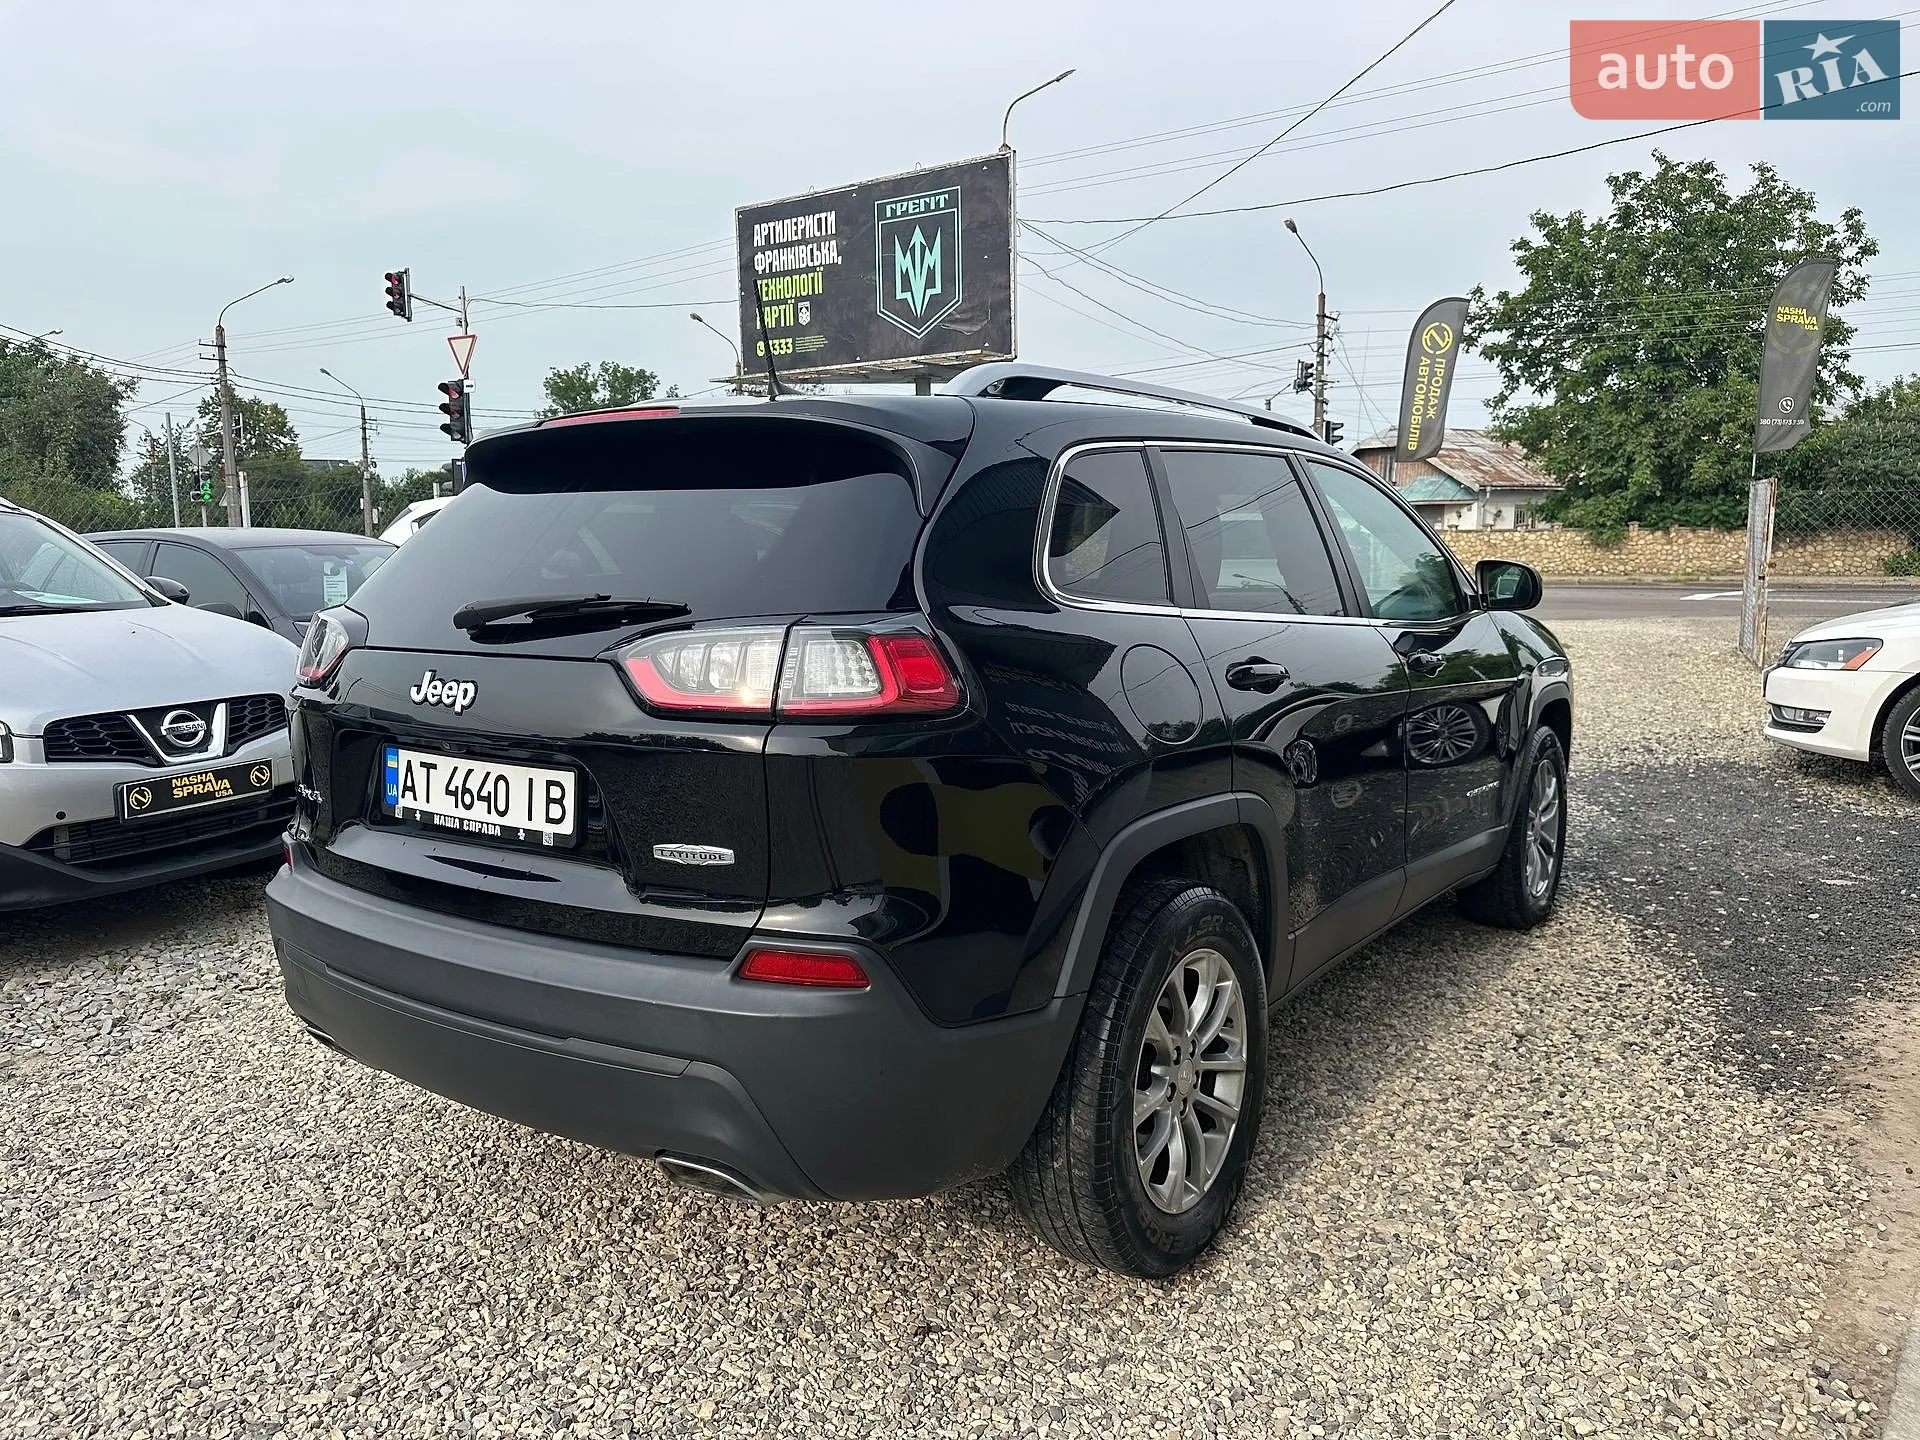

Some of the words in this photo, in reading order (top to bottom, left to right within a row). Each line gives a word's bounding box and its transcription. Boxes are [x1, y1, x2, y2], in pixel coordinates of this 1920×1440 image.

[886, 194, 948, 218] ГРЕГІТ
[753, 210, 836, 248] АРТИЛЕРИСТИ
[754, 240, 842, 275] ФРАНКІВСЬКА,
[1776, 312, 1817, 325] SPRAVA
[1777, 306, 1806, 315] NASHA
[1426, 358, 1446, 419] ПРОДАЖ
[1407, 356, 1431, 451] АВТОМОБІЛІВ
[410, 670, 477, 715] Jeep
[164, 721, 205, 736] NISSAN
[172, 772, 214, 787] NASHA
[173, 778, 231, 798] SPRAVA
[387, 783, 398, 797] UA
[215, 788, 234, 798] USA
[401, 760, 437, 803] AT
[445, 766, 510, 818] 4640
[527, 777, 567, 825] IB
[433, 814, 460, 829] НАША
[463, 820, 502, 837] СПРАВА
[660, 850, 726, 861] LATITUDE
